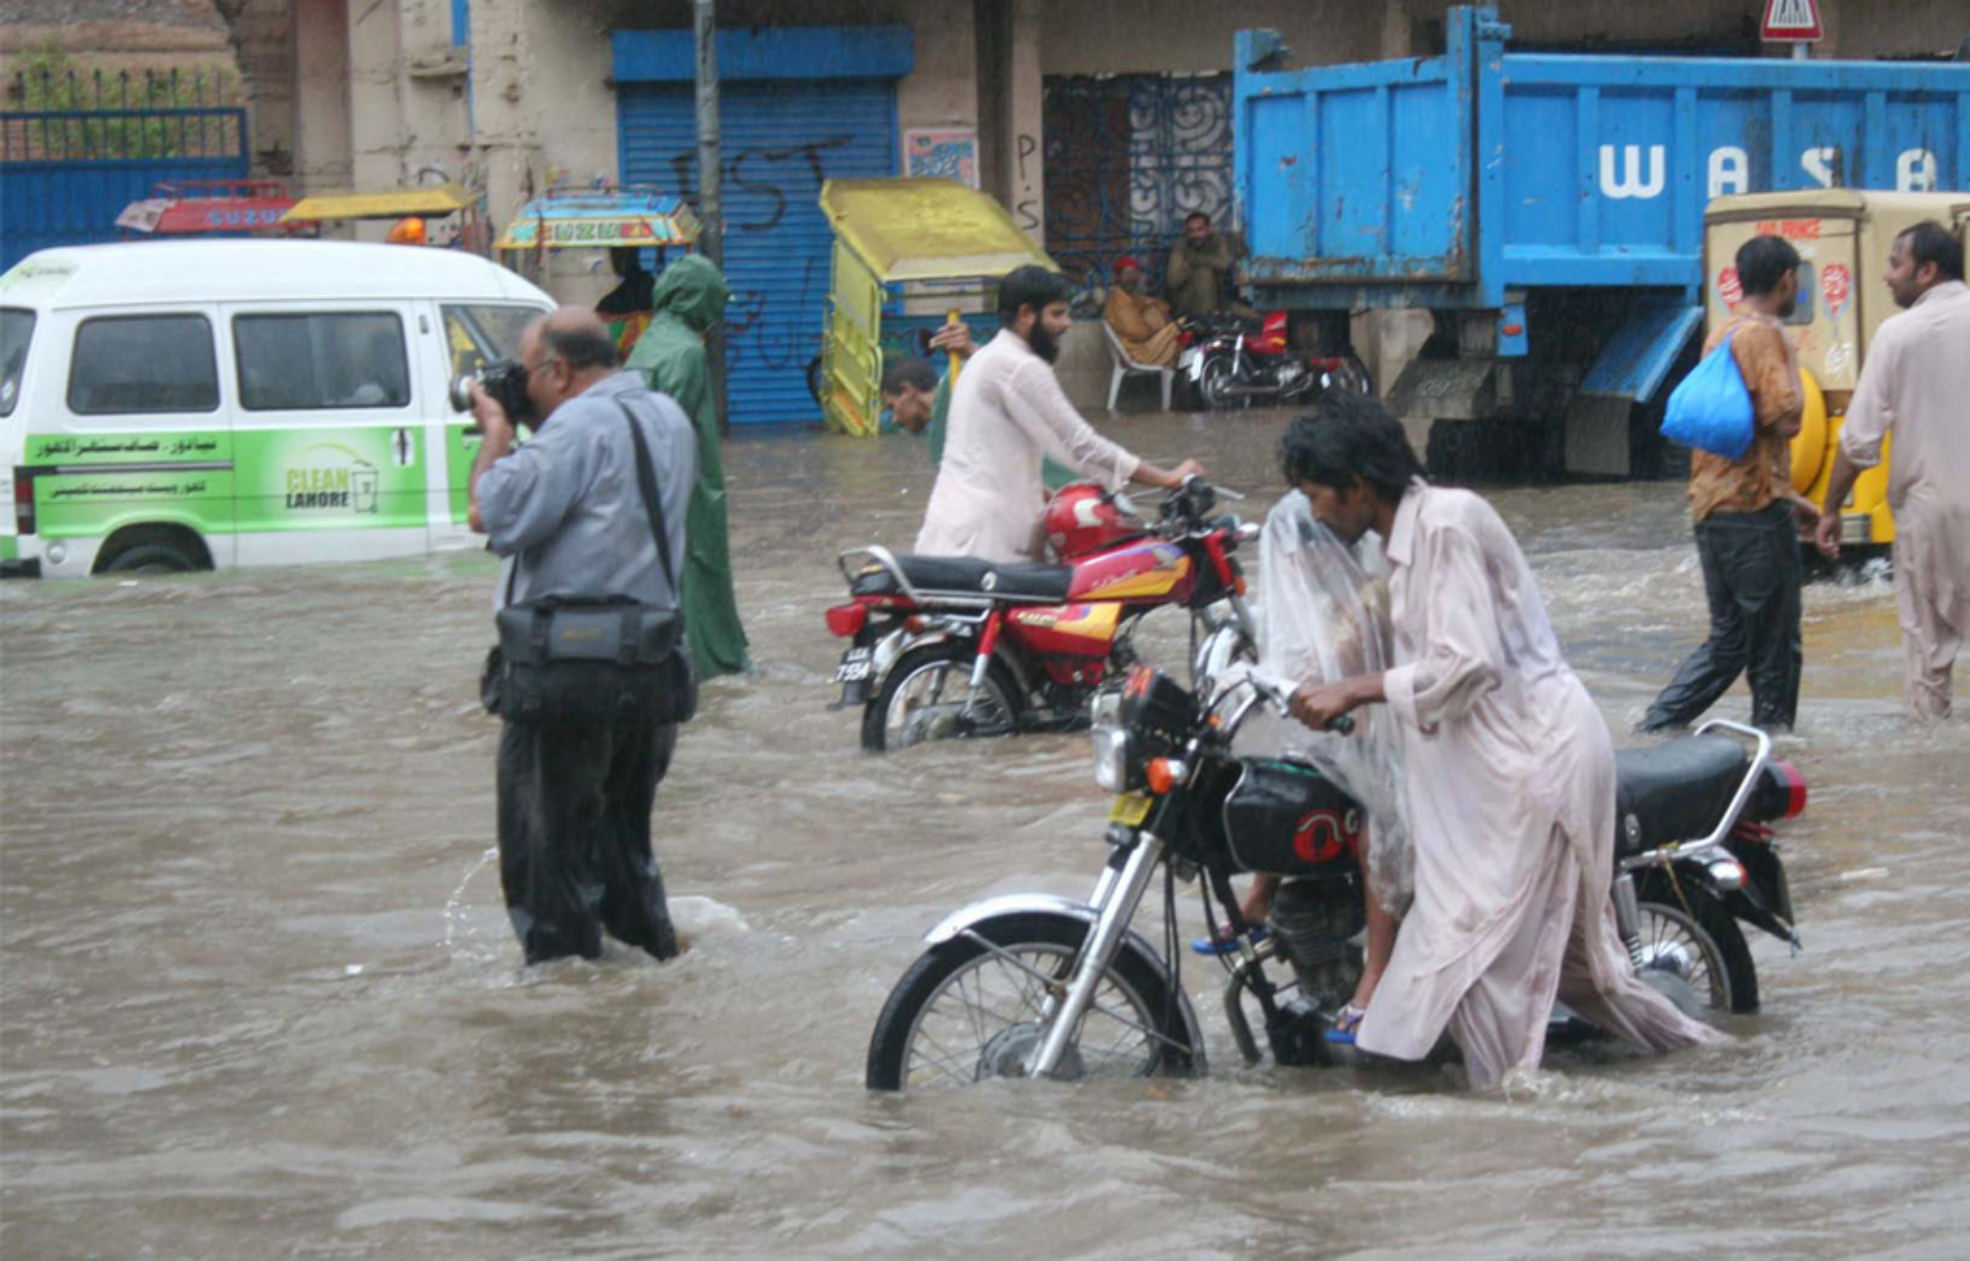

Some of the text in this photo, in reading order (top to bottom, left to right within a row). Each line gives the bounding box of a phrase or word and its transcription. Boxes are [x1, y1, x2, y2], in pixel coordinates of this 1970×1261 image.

[1600, 144, 1936, 198] WASA
[286, 469, 348, 492] CLEAN
[285, 491, 348, 509] LAHORE
